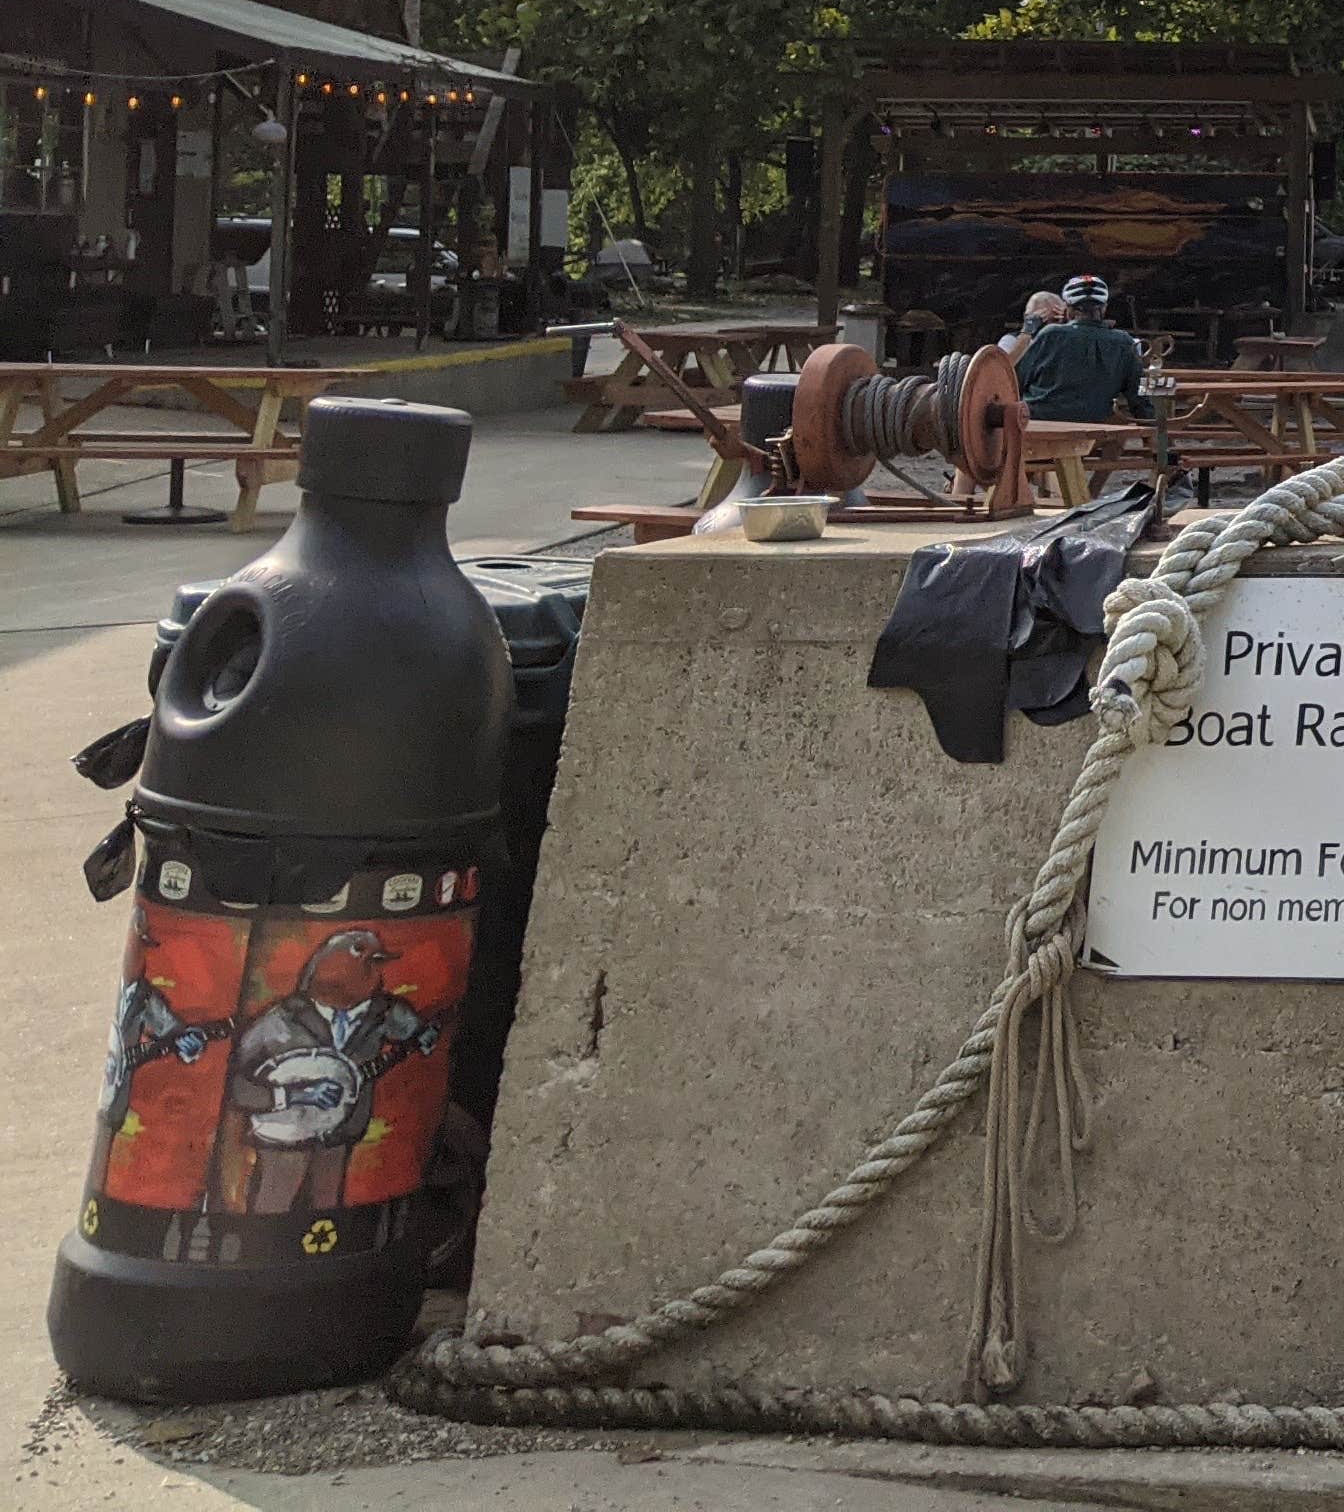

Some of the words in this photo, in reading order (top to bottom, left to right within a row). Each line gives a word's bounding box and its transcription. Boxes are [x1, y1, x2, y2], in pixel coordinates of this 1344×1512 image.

[1130, 840, 1302, 877] Minimum
[1152, 891, 1201, 920] For
[1210, 897, 1266, 922] non
